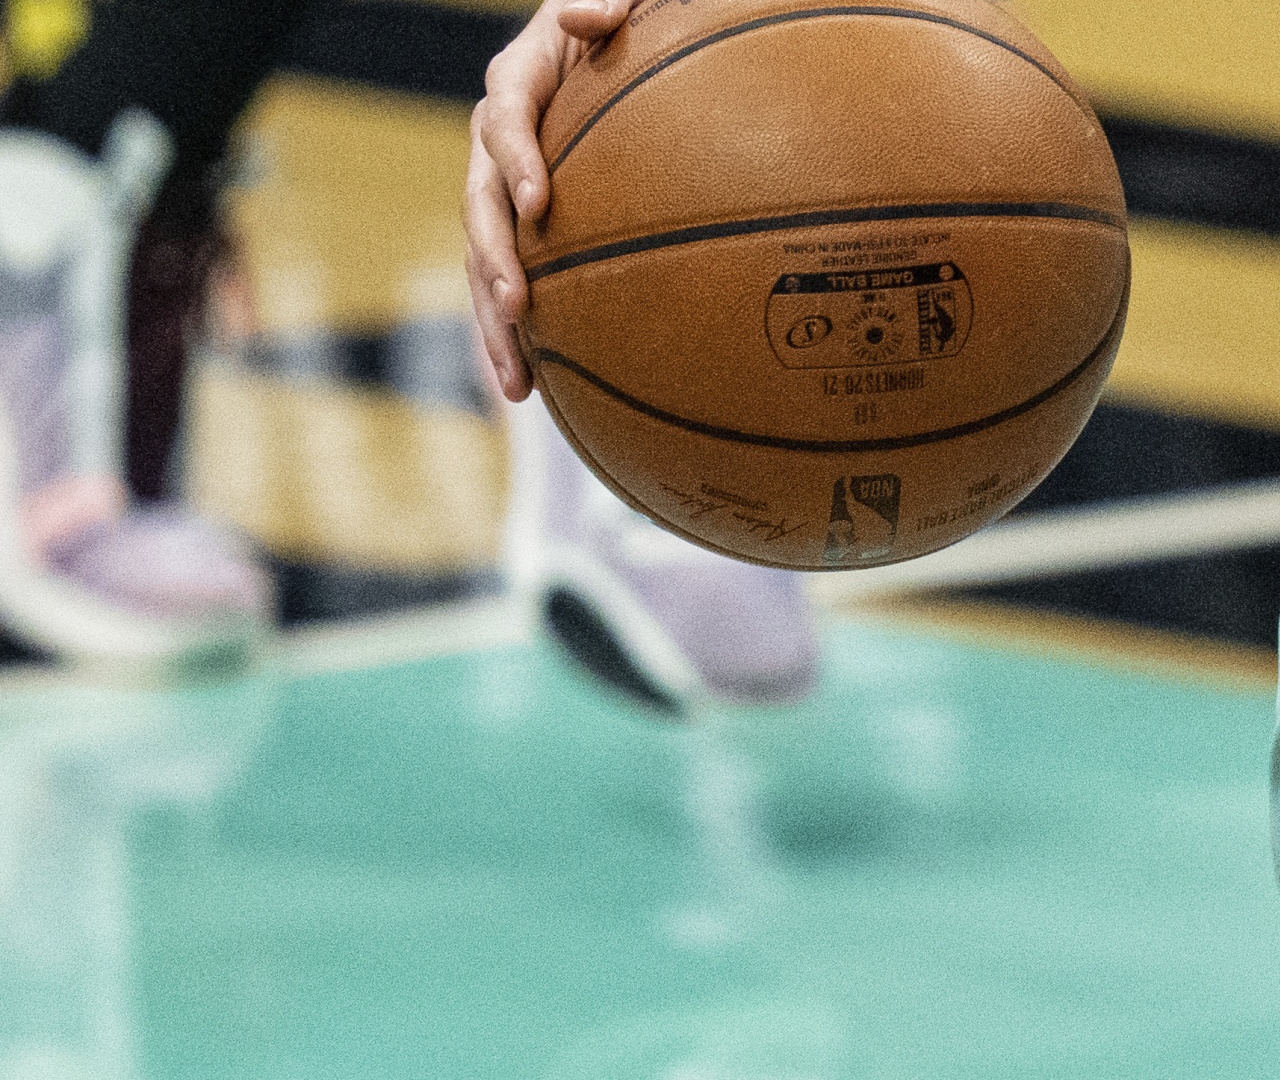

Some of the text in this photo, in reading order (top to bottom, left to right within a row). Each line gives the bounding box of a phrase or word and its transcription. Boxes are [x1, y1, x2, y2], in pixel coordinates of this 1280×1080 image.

[782, 243, 816, 255] CHINA
[821, 253, 868, 267] LEATHER
[827, 271, 914, 289] GAME BALL
[859, 478, 894, 499] NBA
